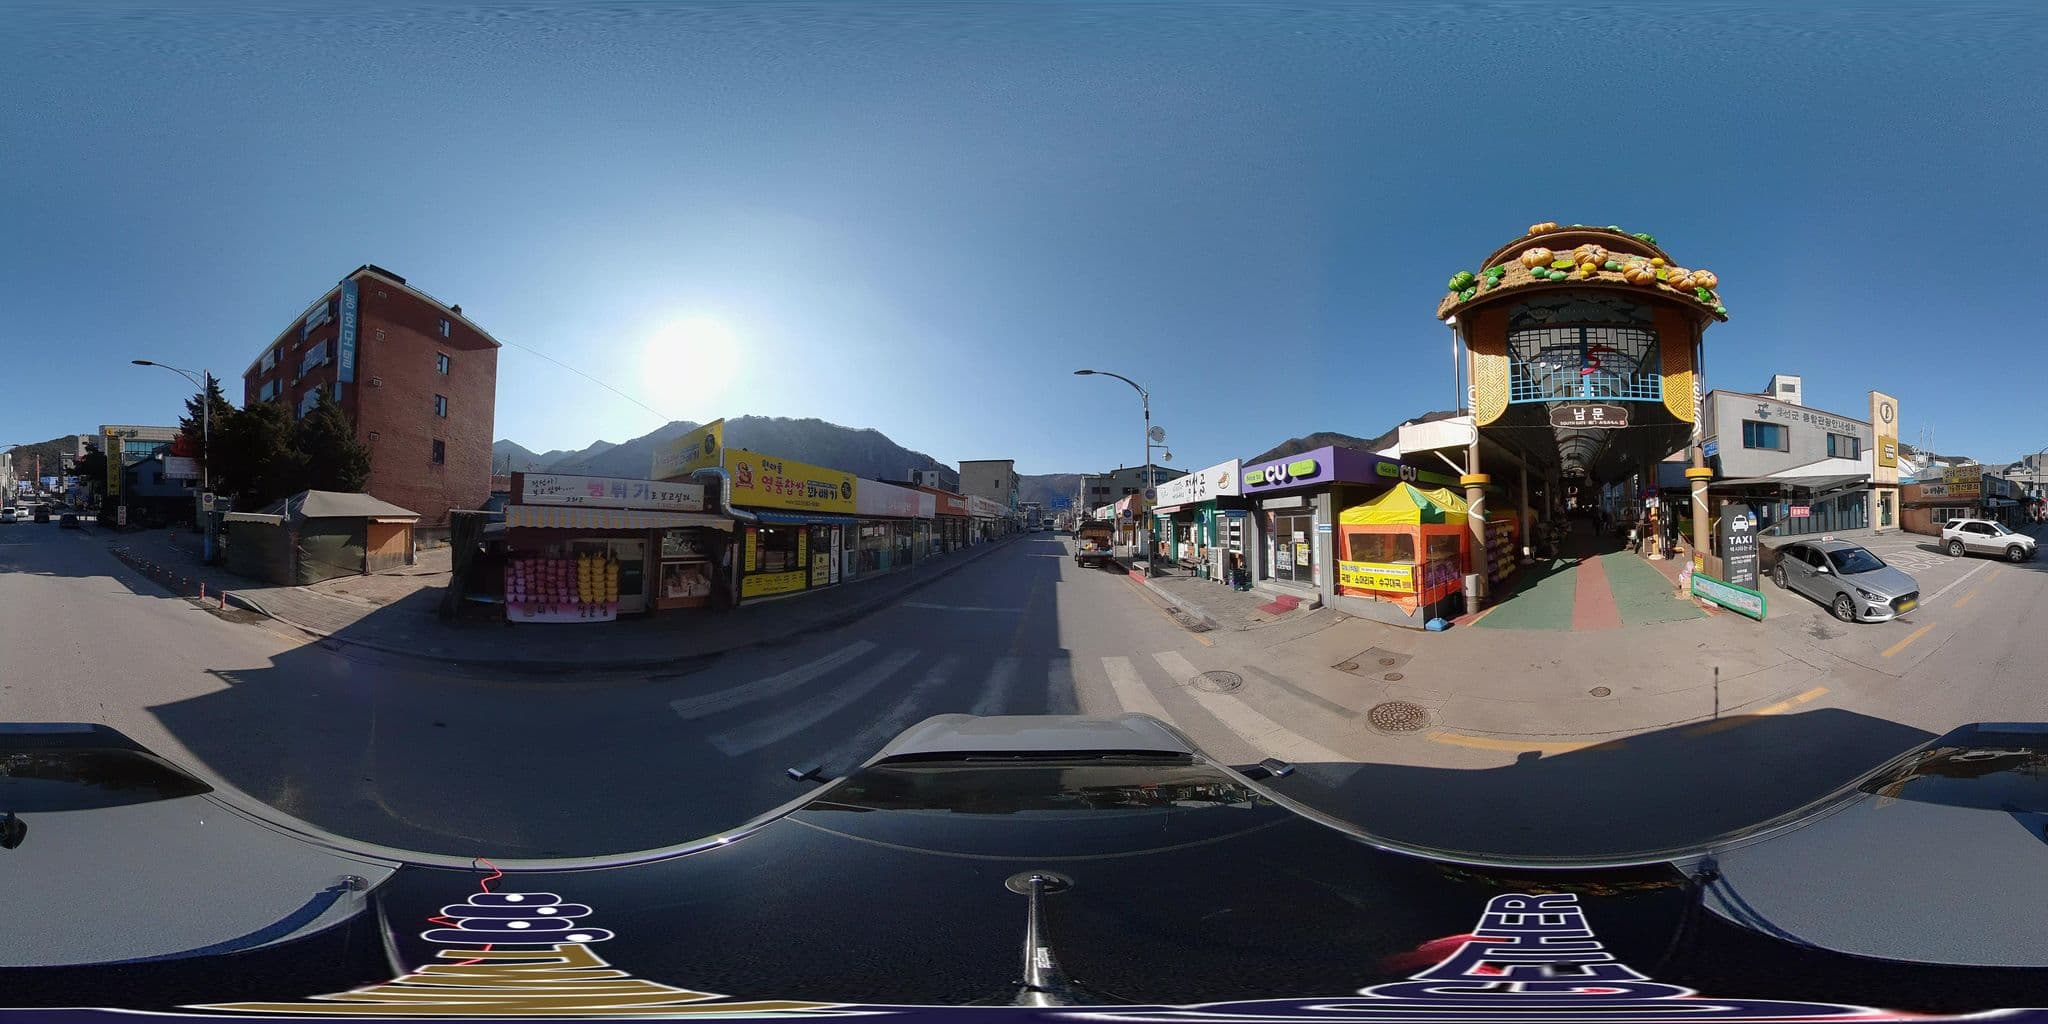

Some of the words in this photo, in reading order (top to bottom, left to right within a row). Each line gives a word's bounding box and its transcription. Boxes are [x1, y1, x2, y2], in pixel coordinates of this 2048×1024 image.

[1573, 407, 1604, 421] 남문
[1265, 463, 1287, 482] CU
[1400, 464, 1417, 481] CU
[1729, 536, 1752, 544] TAXI
